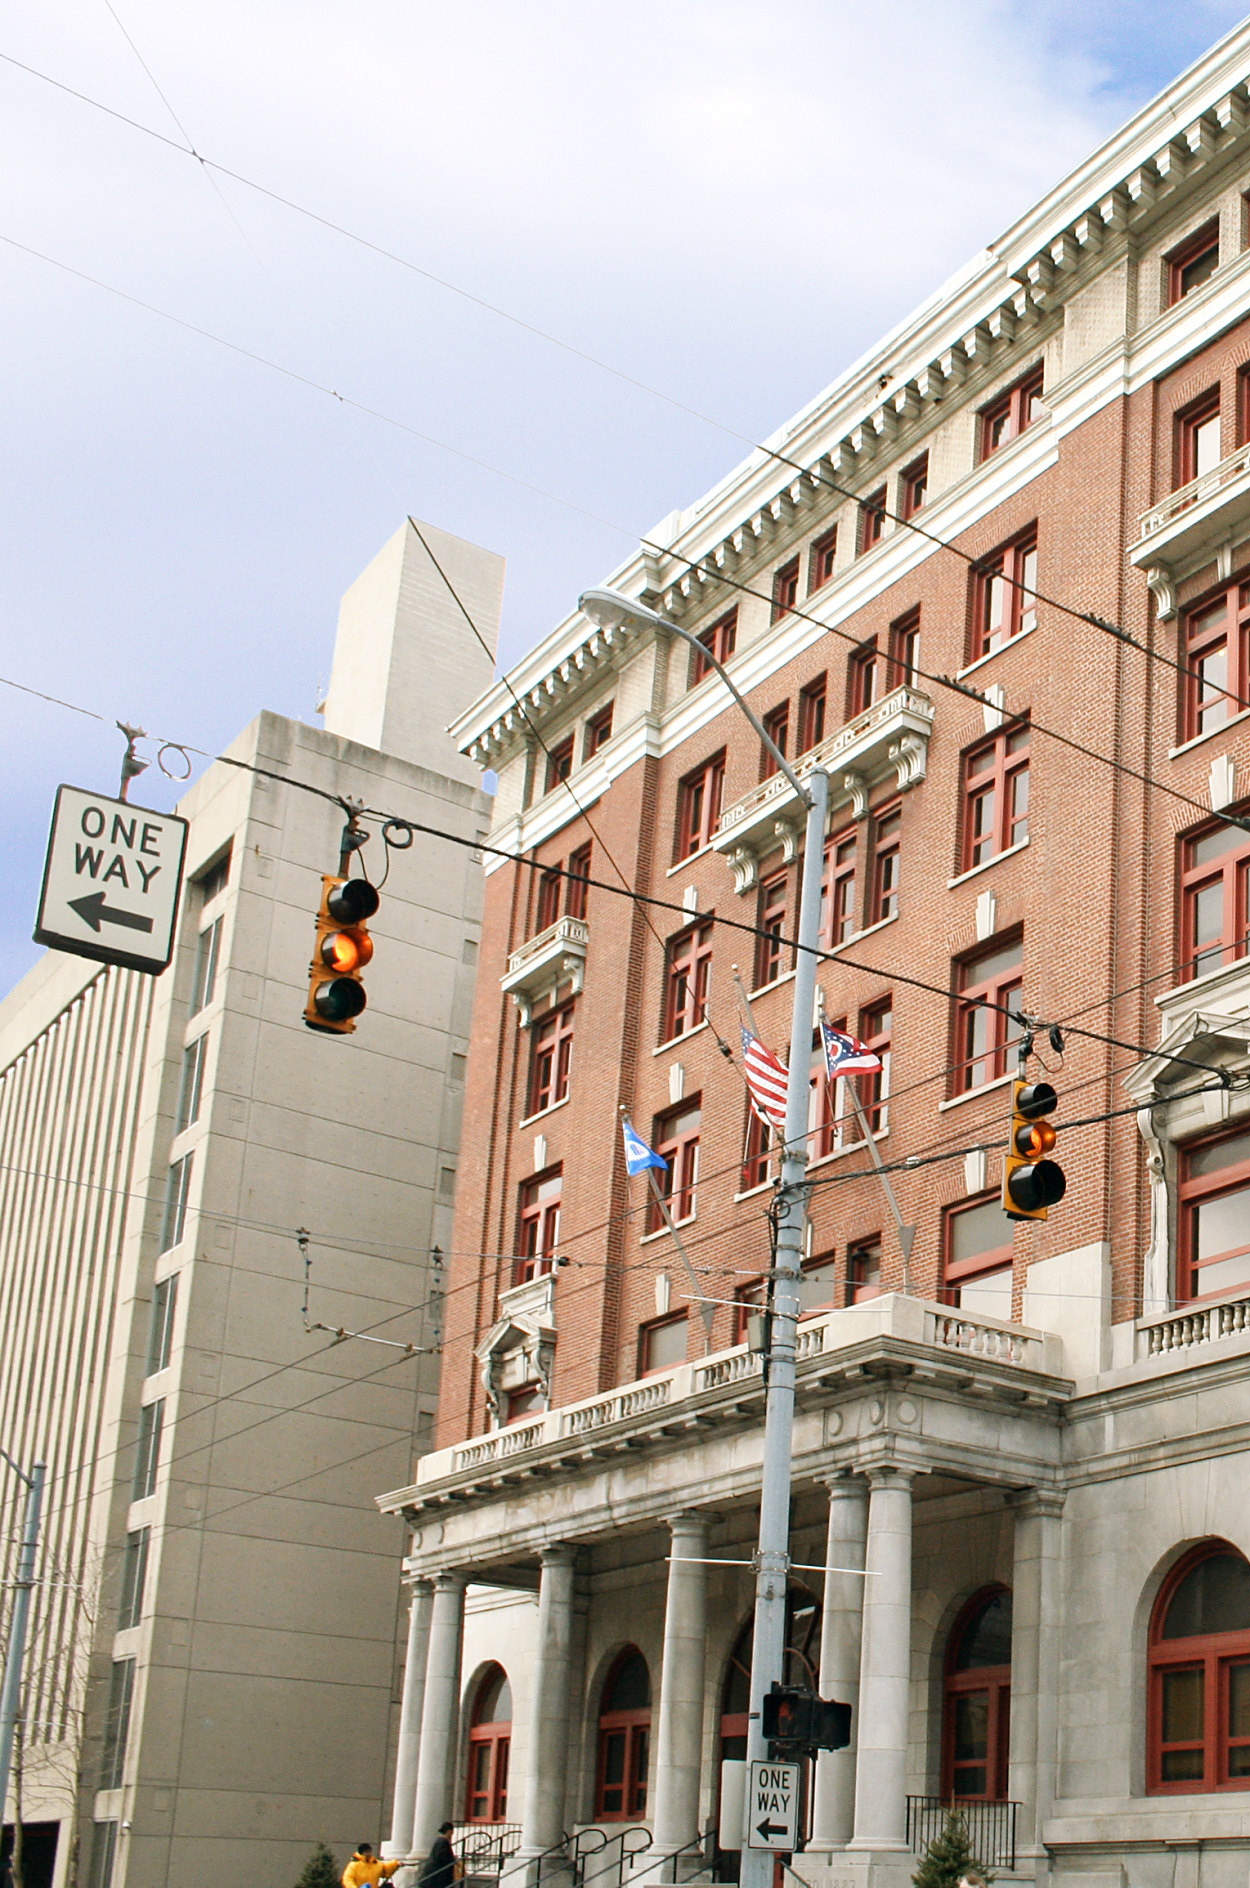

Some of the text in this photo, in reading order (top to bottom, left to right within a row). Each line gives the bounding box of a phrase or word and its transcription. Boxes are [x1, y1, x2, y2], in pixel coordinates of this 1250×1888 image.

[81, 806, 163, 857] ONE
[74, 842, 162, 894] WAY
[759, 1768, 790, 1789] ONE
[757, 1792, 791, 1813] WAY
